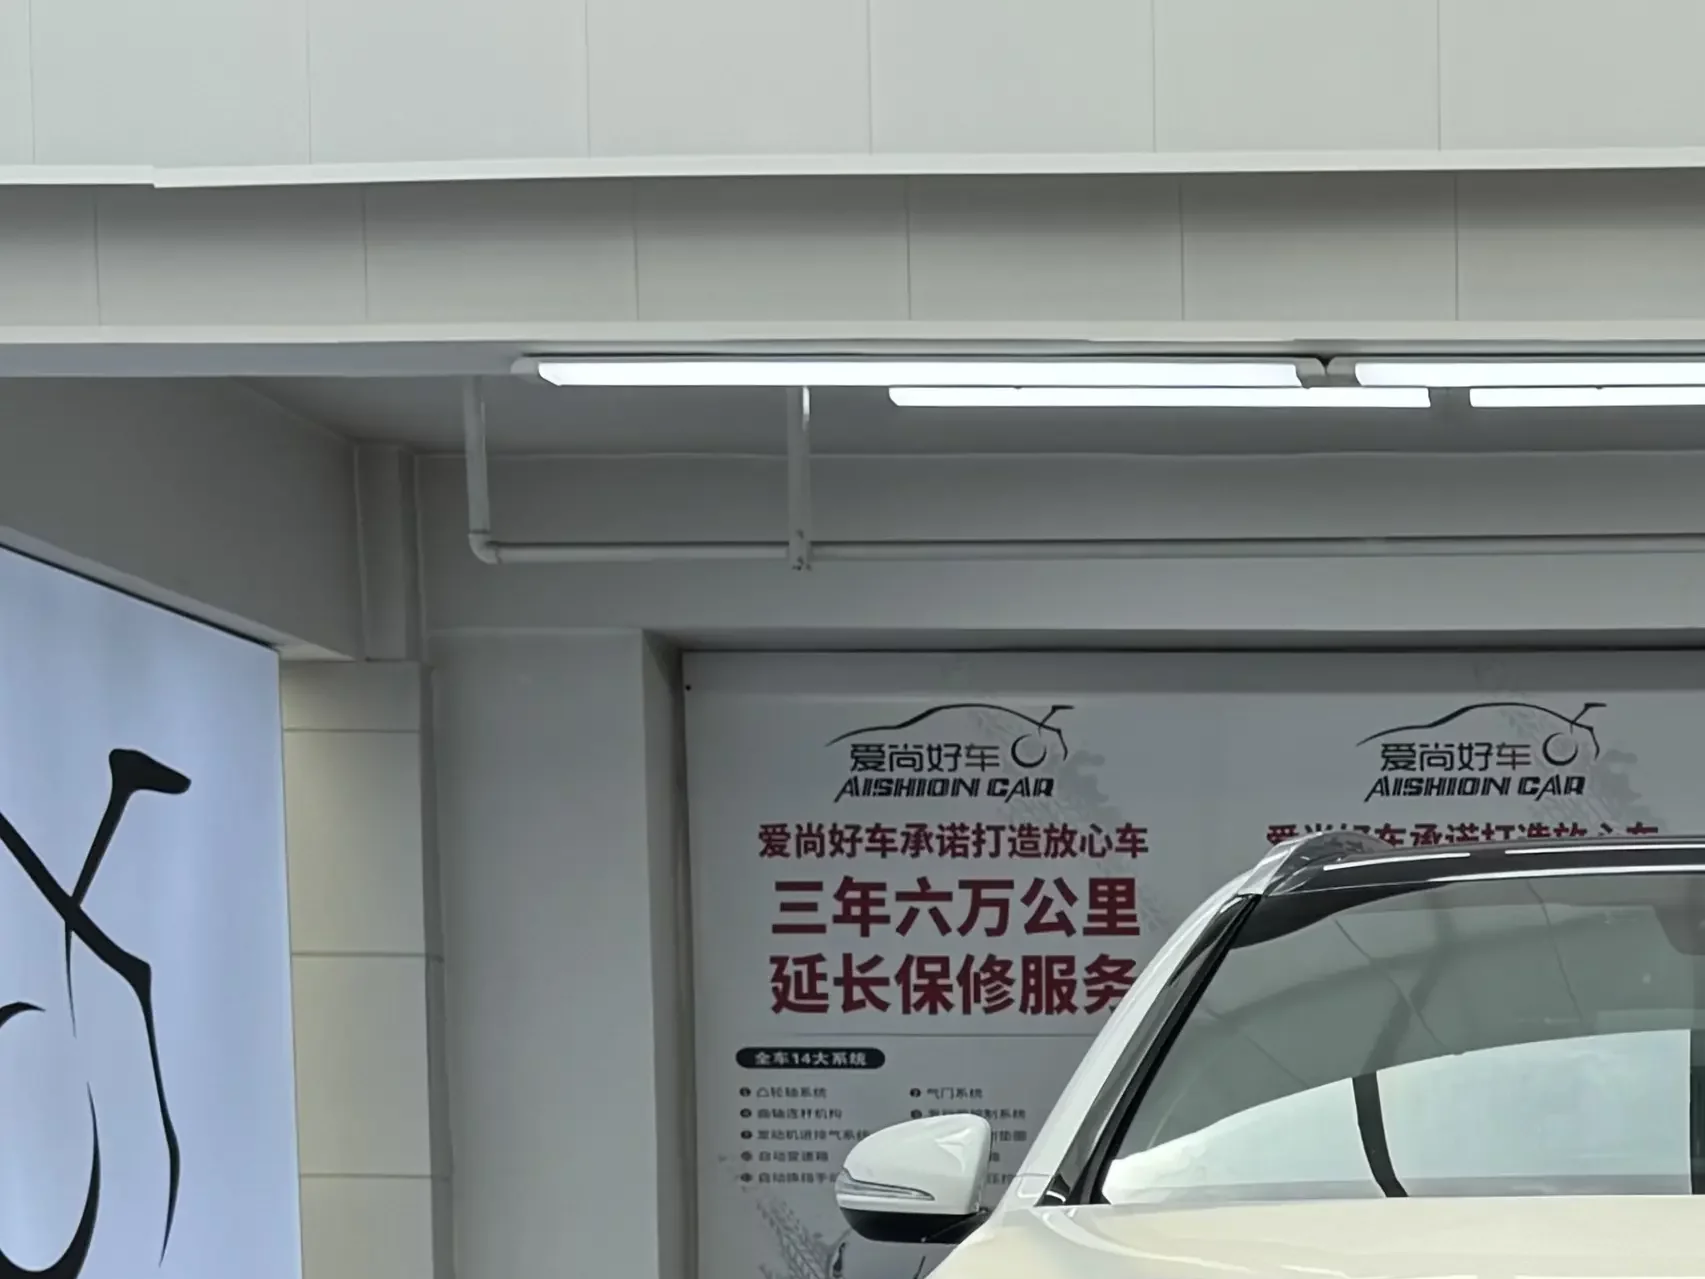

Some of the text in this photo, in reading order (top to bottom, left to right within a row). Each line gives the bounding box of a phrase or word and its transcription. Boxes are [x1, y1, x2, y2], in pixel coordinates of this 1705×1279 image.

[850, 743, 1000, 773] 爱尚好车
[1380, 742, 1531, 772] 爱尚好车
[834, 776, 1055, 803] AISHION CAR
[1363, 774, 1586, 803] AISHION CAR
[758, 822, 1149, 859] 爱尚好车承诺打造放心车
[771, 875, 1141, 938] 三年六万公里
[769, 952, 1138, 1016] 延长保修服务
